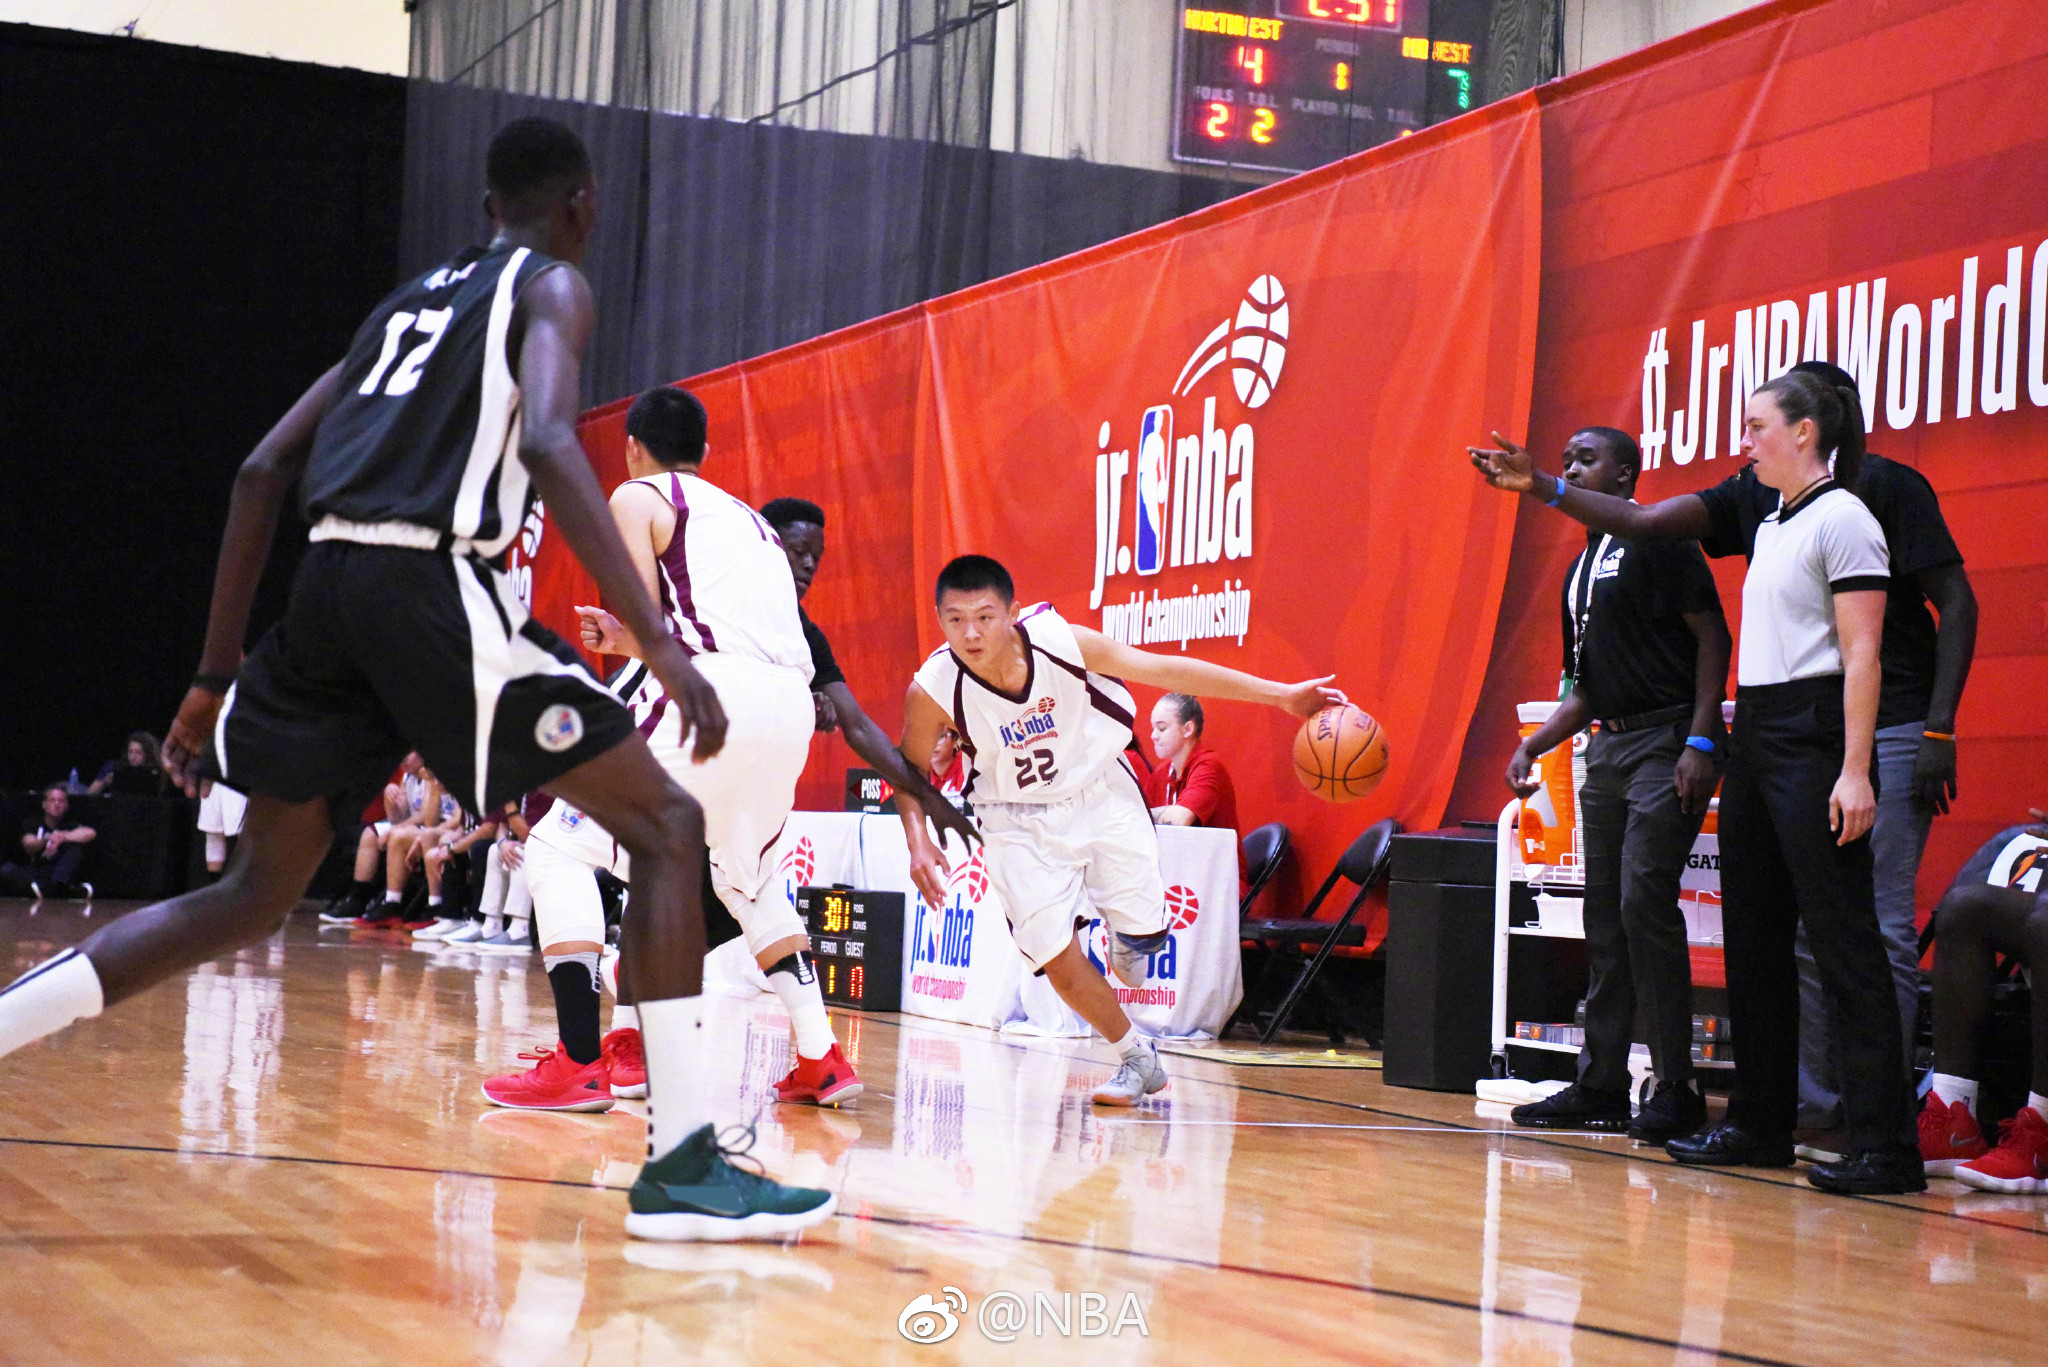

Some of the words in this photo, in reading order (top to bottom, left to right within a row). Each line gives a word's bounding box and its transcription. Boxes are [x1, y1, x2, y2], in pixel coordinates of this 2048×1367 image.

[1238, 46, 1264, 84] 4
[1336, 62, 1348, 90] 1
[1447, 68, 1469, 109] 7
[1207, 103, 1229, 138] 2
[1251, 108, 1275, 143] 2
[358, 306, 454, 396] 12
[1170, 396, 1254, 568] nba
[1102, 591, 1144, 646] world
[1143, 578, 1251, 651] championship
[1014, 748, 1059, 790] 22
[861, 778, 881, 800] POSS
[820, 940, 838, 955] PERIOD
[845, 940, 865, 957] GUEST
[940, 892, 975, 969] nba
[828, 964, 836, 995] 1
[1113, 986, 1176, 1010] ampionship
